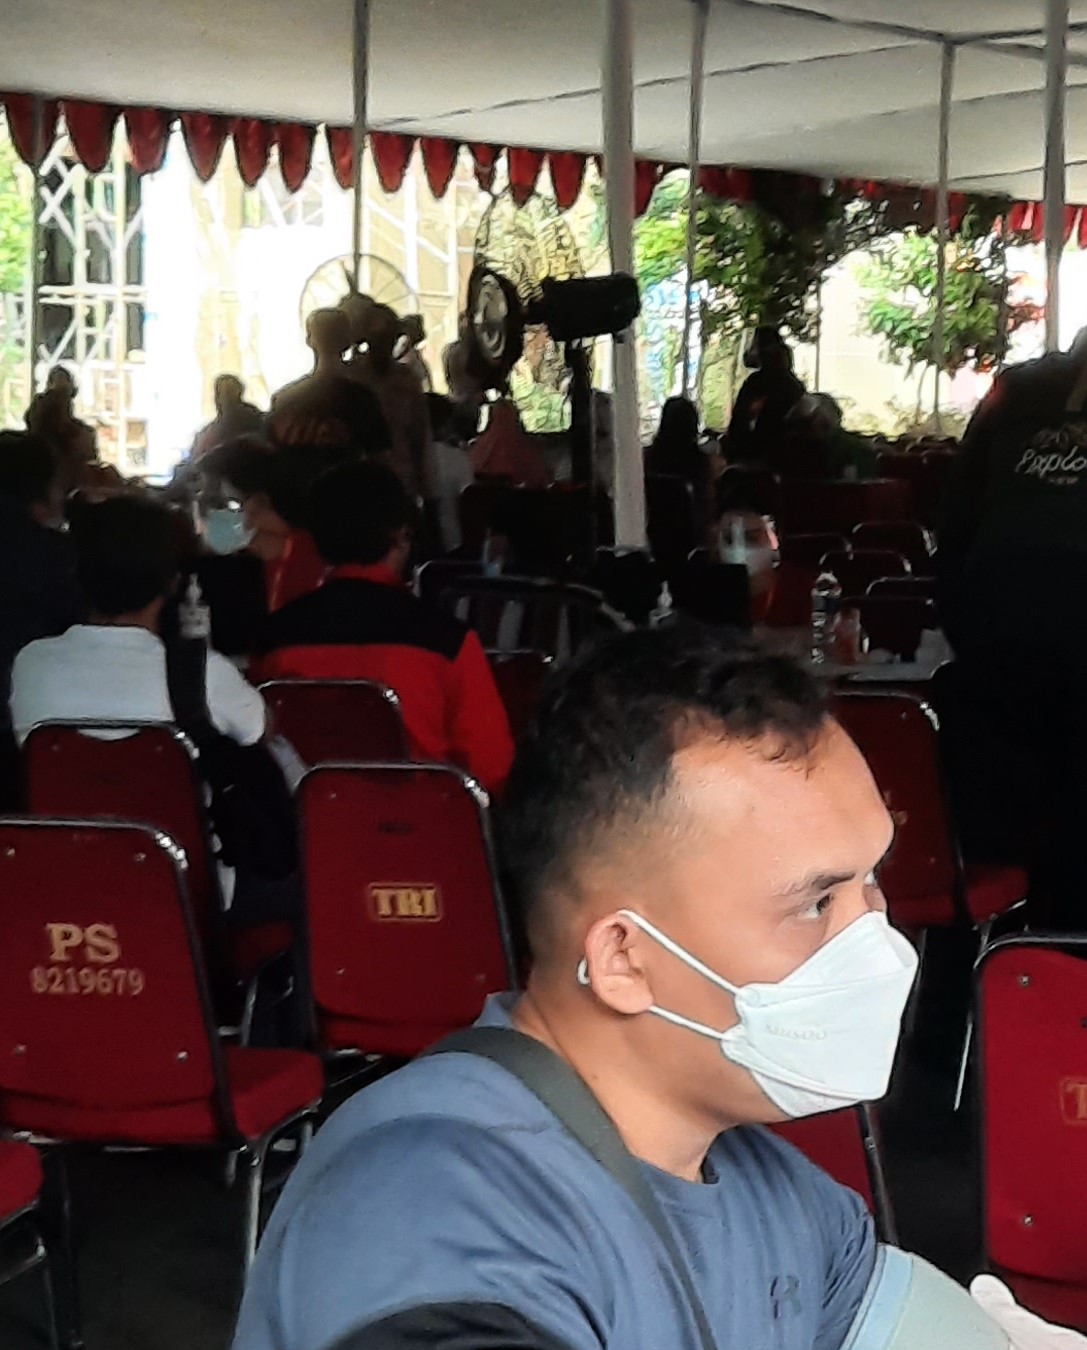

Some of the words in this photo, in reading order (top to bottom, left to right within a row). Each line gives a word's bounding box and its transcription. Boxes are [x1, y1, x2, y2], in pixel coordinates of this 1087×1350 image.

[372, 888, 437, 917] TRI
[45, 922, 121, 963] PS
[30, 966, 144, 996] 8219679
